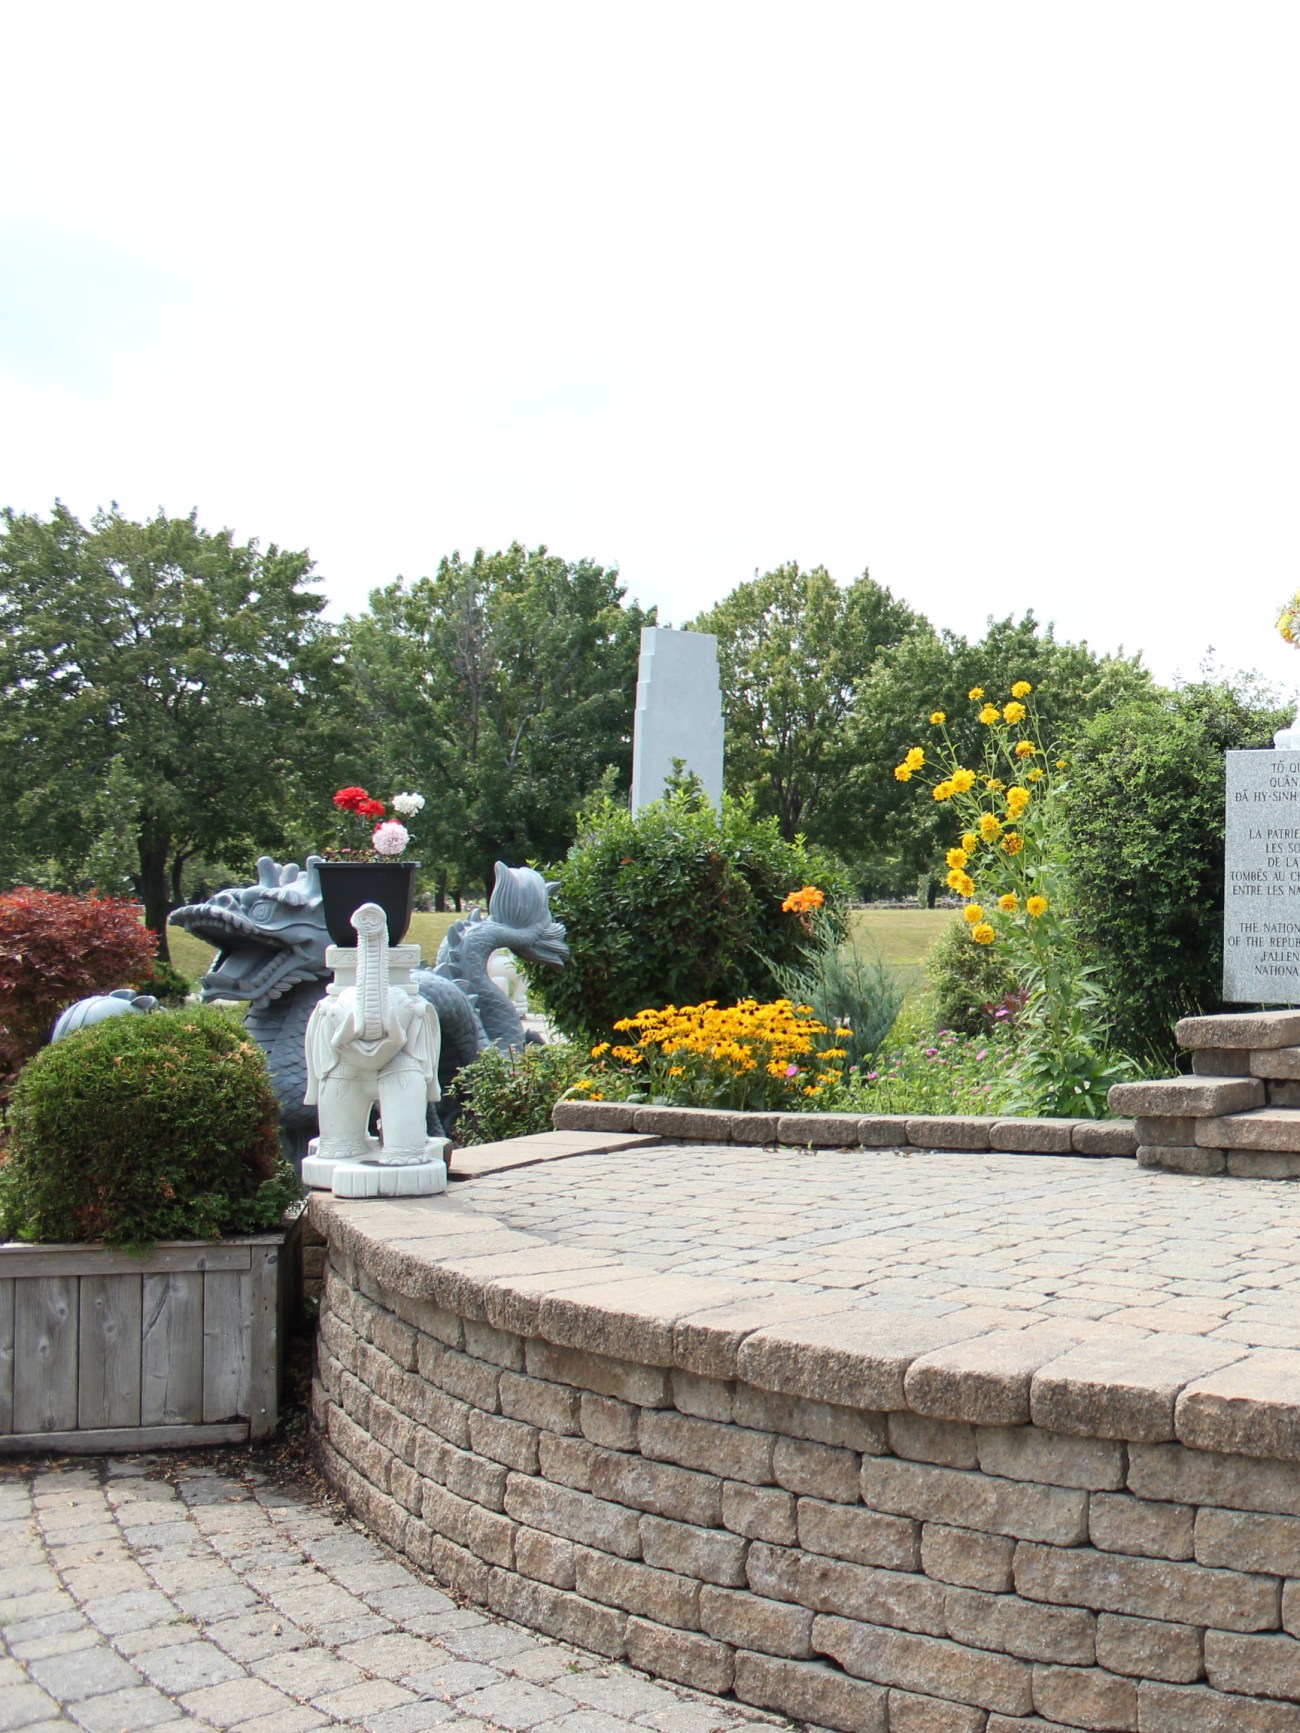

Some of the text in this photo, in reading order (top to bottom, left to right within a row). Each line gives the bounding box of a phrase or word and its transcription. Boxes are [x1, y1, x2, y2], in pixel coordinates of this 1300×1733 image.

[1254, 792, 1297, 802] HY-SINH
[1249, 829, 1261, 839] LA
[1268, 829, 1300, 839] PATRIE
[1266, 843, 1283, 853] LES
[1268, 857, 1280, 867] DE
[1286, 857, 1299, 867] LA
[1273, 872, 1285, 881] AU
[1233, 886, 1262, 896] ENTRE
[1267, 886, 1284, 896] LES
[1240, 923, 1259, 933] THE
[1264, 923, 1300, 934] NATION
[1228, 937, 1240, 946] OF
[1246, 937, 1264, 947] THE
[1262, 952, 1300, 961] FALLEN
